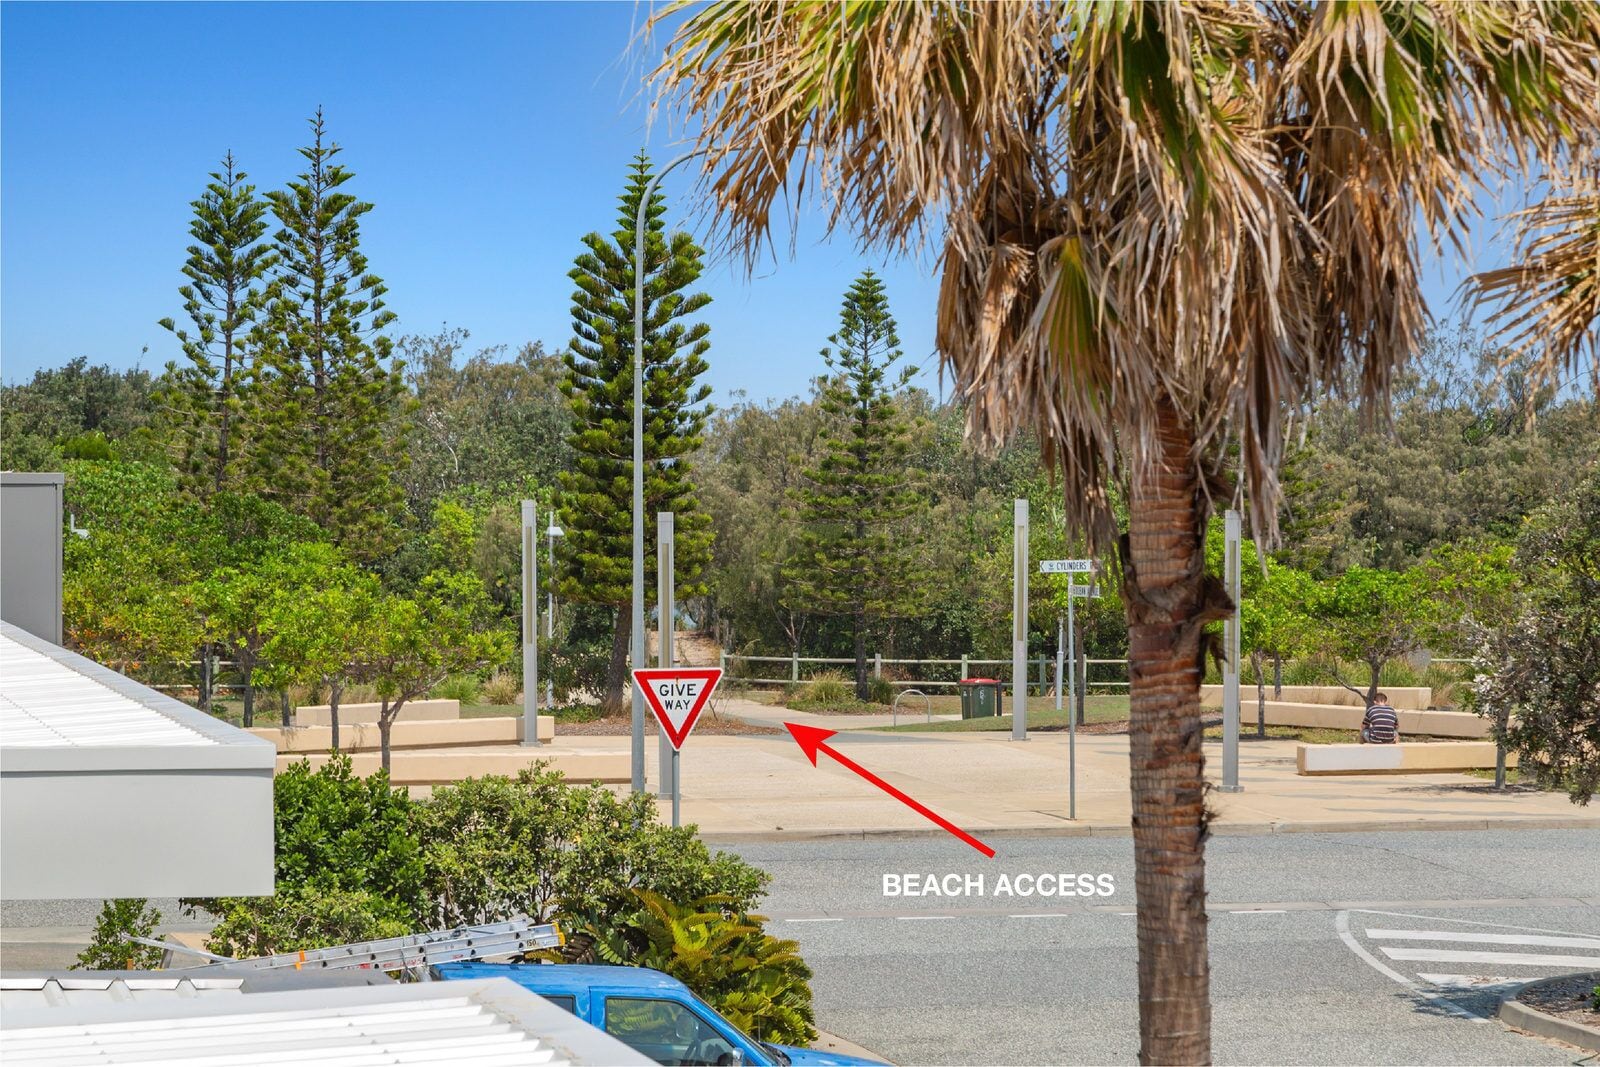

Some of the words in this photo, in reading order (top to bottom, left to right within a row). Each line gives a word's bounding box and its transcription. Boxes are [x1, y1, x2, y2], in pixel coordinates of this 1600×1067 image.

[1056, 561, 1087, 571] CYLINDERS
[659, 683, 697, 697] GIVE
[664, 699, 691, 710] WAY
